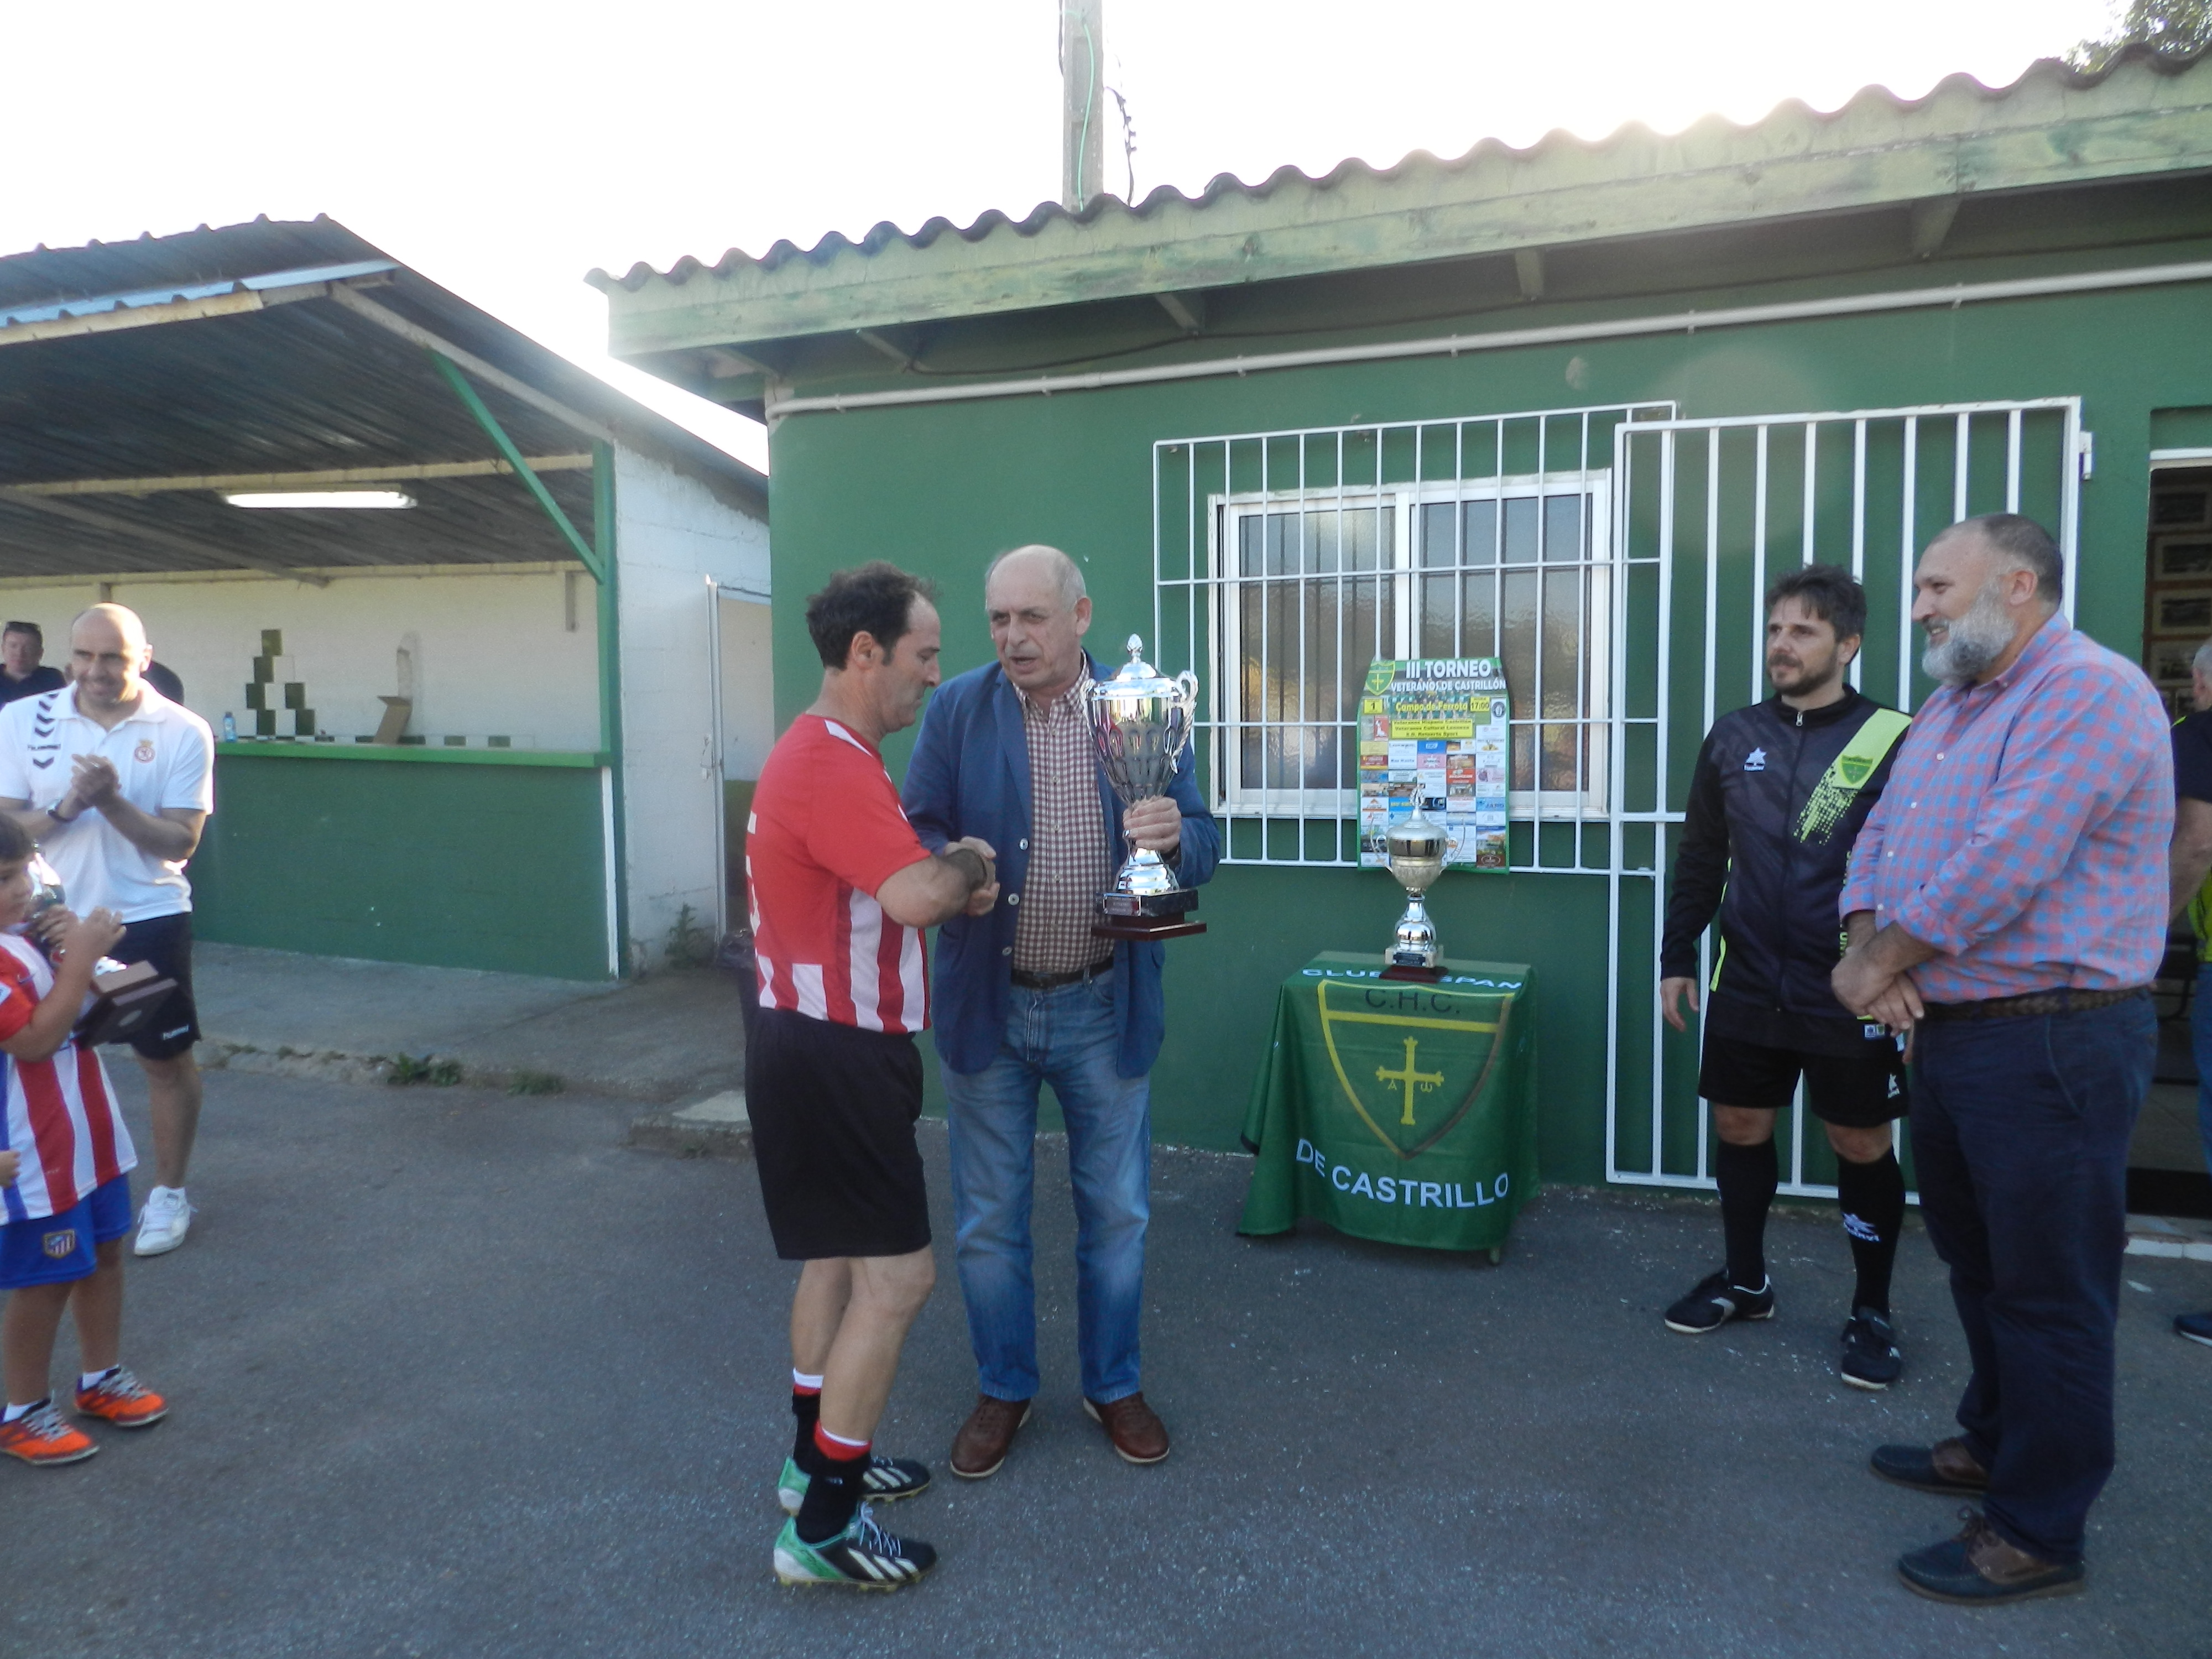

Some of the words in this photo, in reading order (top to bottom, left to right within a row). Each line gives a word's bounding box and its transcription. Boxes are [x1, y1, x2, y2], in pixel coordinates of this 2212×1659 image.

[1406, 661, 1421, 679] III
[1425, 659, 1491, 679] TORNEO
[1391, 680, 1438, 692] VETERANOS
[1440, 680, 1453, 691] DE
[1454, 677, 1506, 691] CASTRILLÓN
[1396, 702, 1424, 713] Campo
[1426, 701, 1436, 712] de
[1470, 702, 1490, 710] 17:00
[1439, 975, 1522, 989] SPAN
[1296, 1138, 1326, 1178] DE
[1331, 1165, 1509, 1208] CASTRILLO
